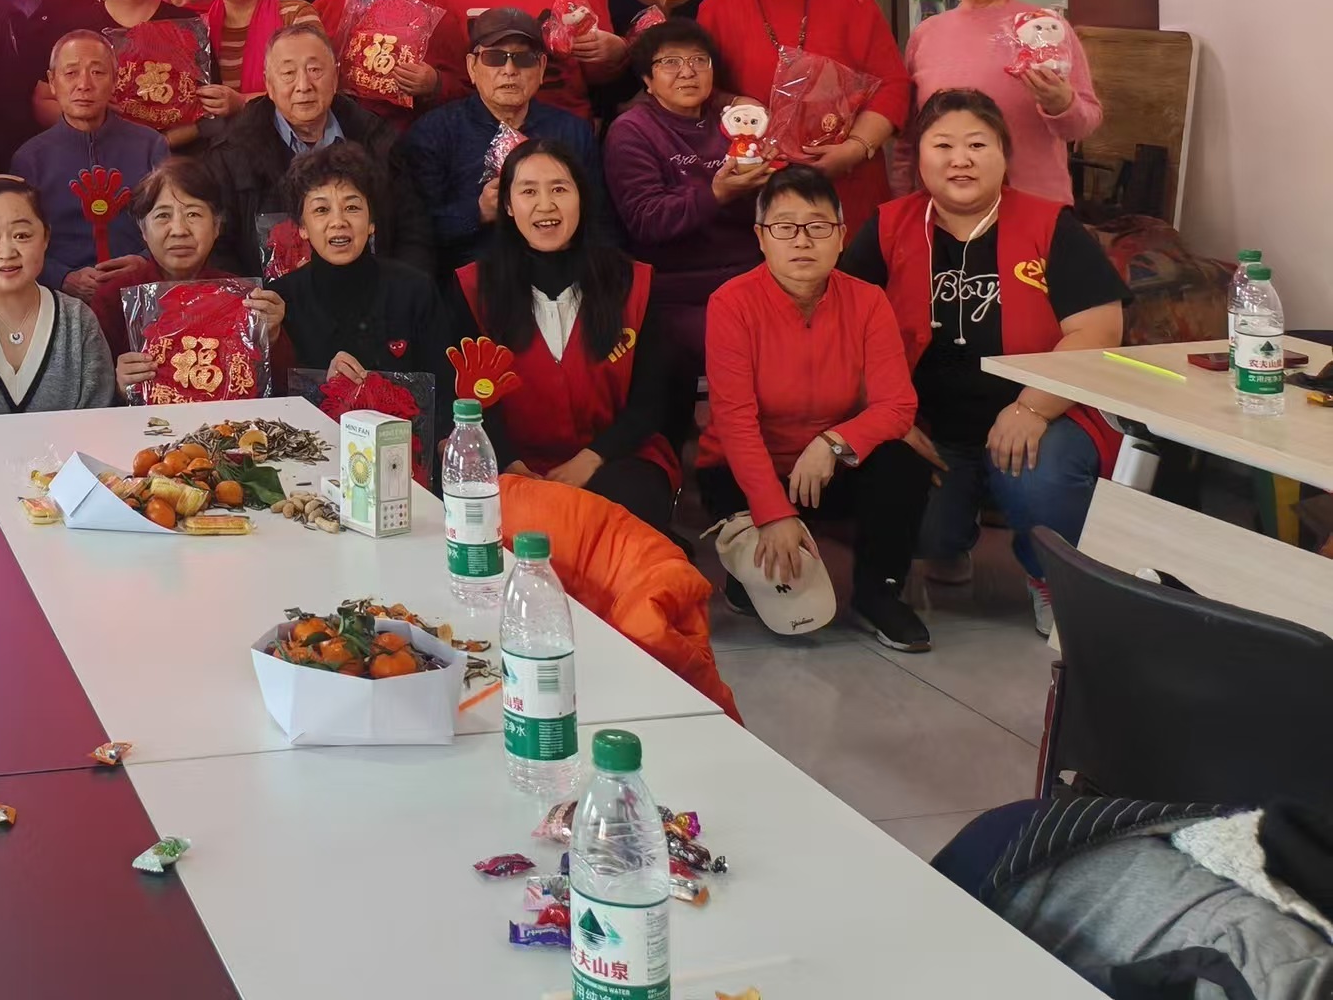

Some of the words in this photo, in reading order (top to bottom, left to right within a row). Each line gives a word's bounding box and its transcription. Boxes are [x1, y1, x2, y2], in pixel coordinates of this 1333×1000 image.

[363, 33, 396, 75] 福
[134, 61, 174, 104] 福
[170, 335, 224, 392] 福
